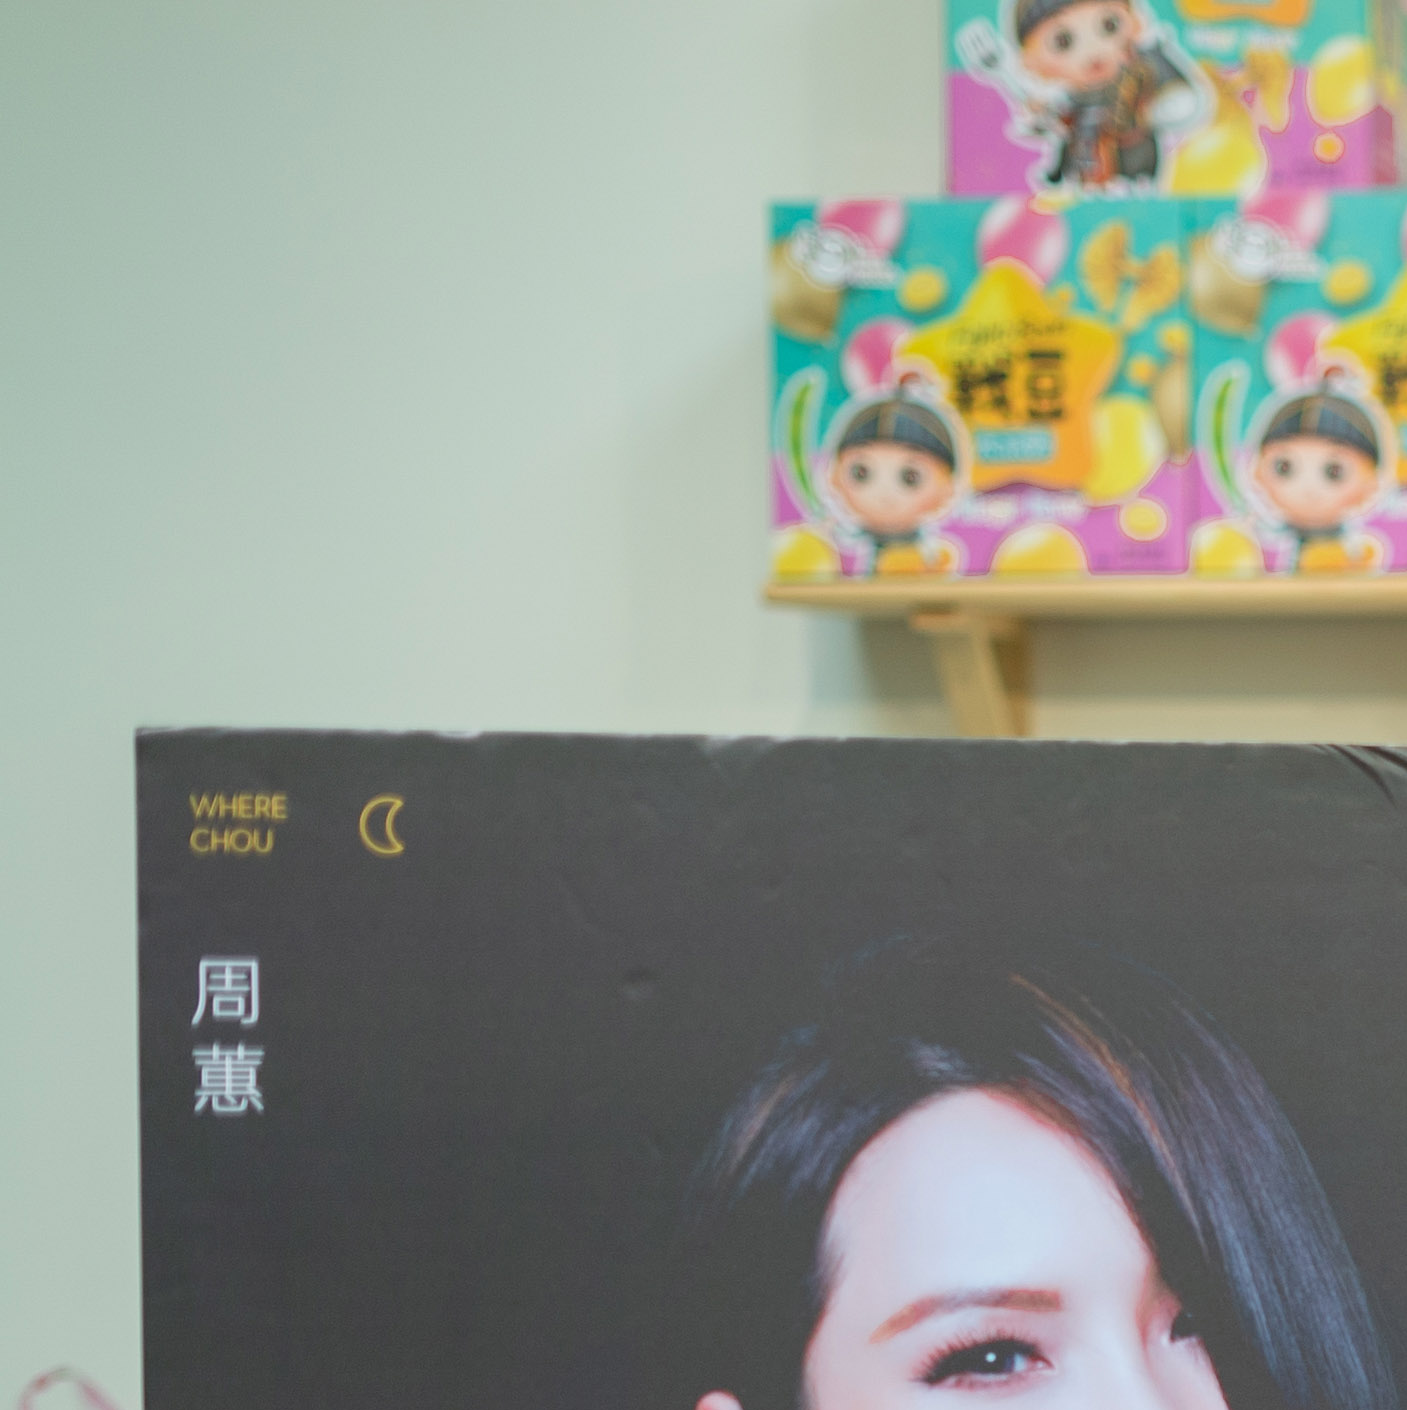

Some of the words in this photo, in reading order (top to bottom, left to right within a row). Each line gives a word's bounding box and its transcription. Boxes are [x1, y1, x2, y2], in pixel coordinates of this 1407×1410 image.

[190, 793, 288, 820] WHERE
[189, 827, 275, 855] CHOU
[191, 956, 265, 1115] 周蕙
